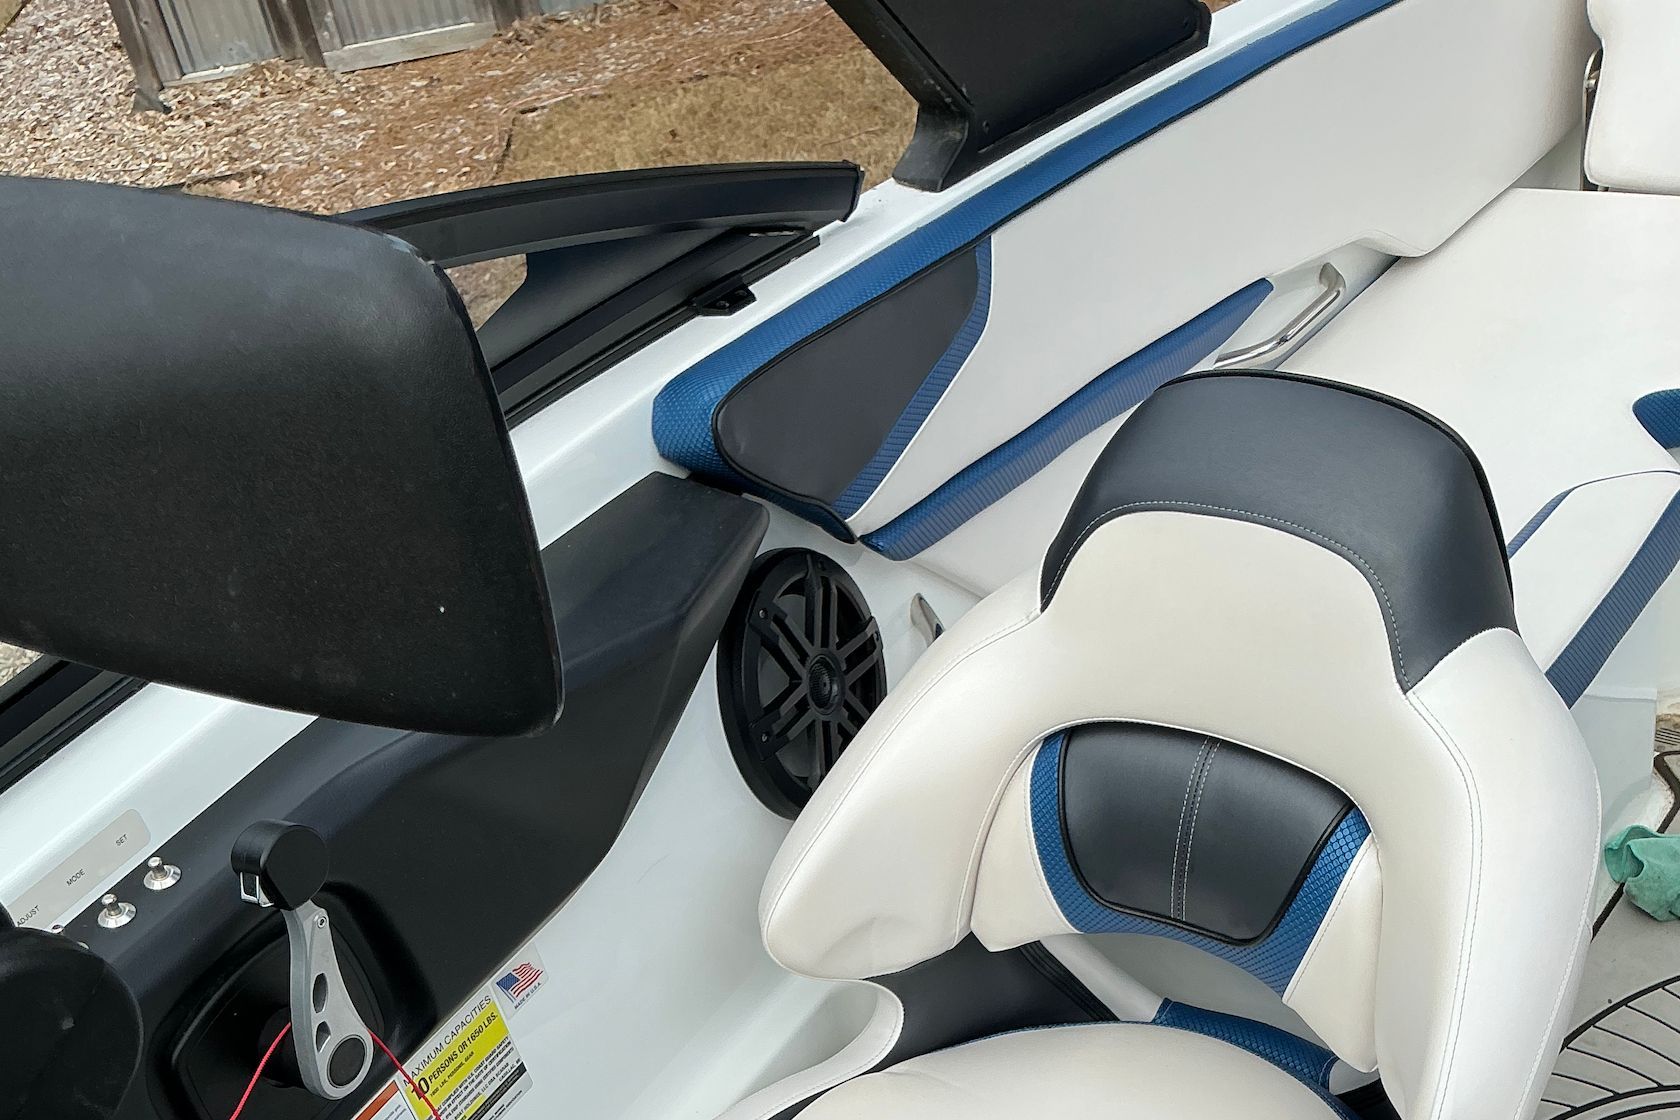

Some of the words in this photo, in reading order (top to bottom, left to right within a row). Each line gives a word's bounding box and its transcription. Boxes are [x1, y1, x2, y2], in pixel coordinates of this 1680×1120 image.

[115, 834, 128, 846] SET
[66, 869, 86, 886] MODE
[16, 905, 40, 927] ADJUST
[514, 997, 526, 1010] MADE
[444, 995, 492, 1045] CAPACITIES
[429, 1051, 459, 1083] PERSONS
[457, 1041, 468, 1055] OR
[467, 1023, 485, 1046] 1650
[482, 1011, 499, 1031] LBS.
